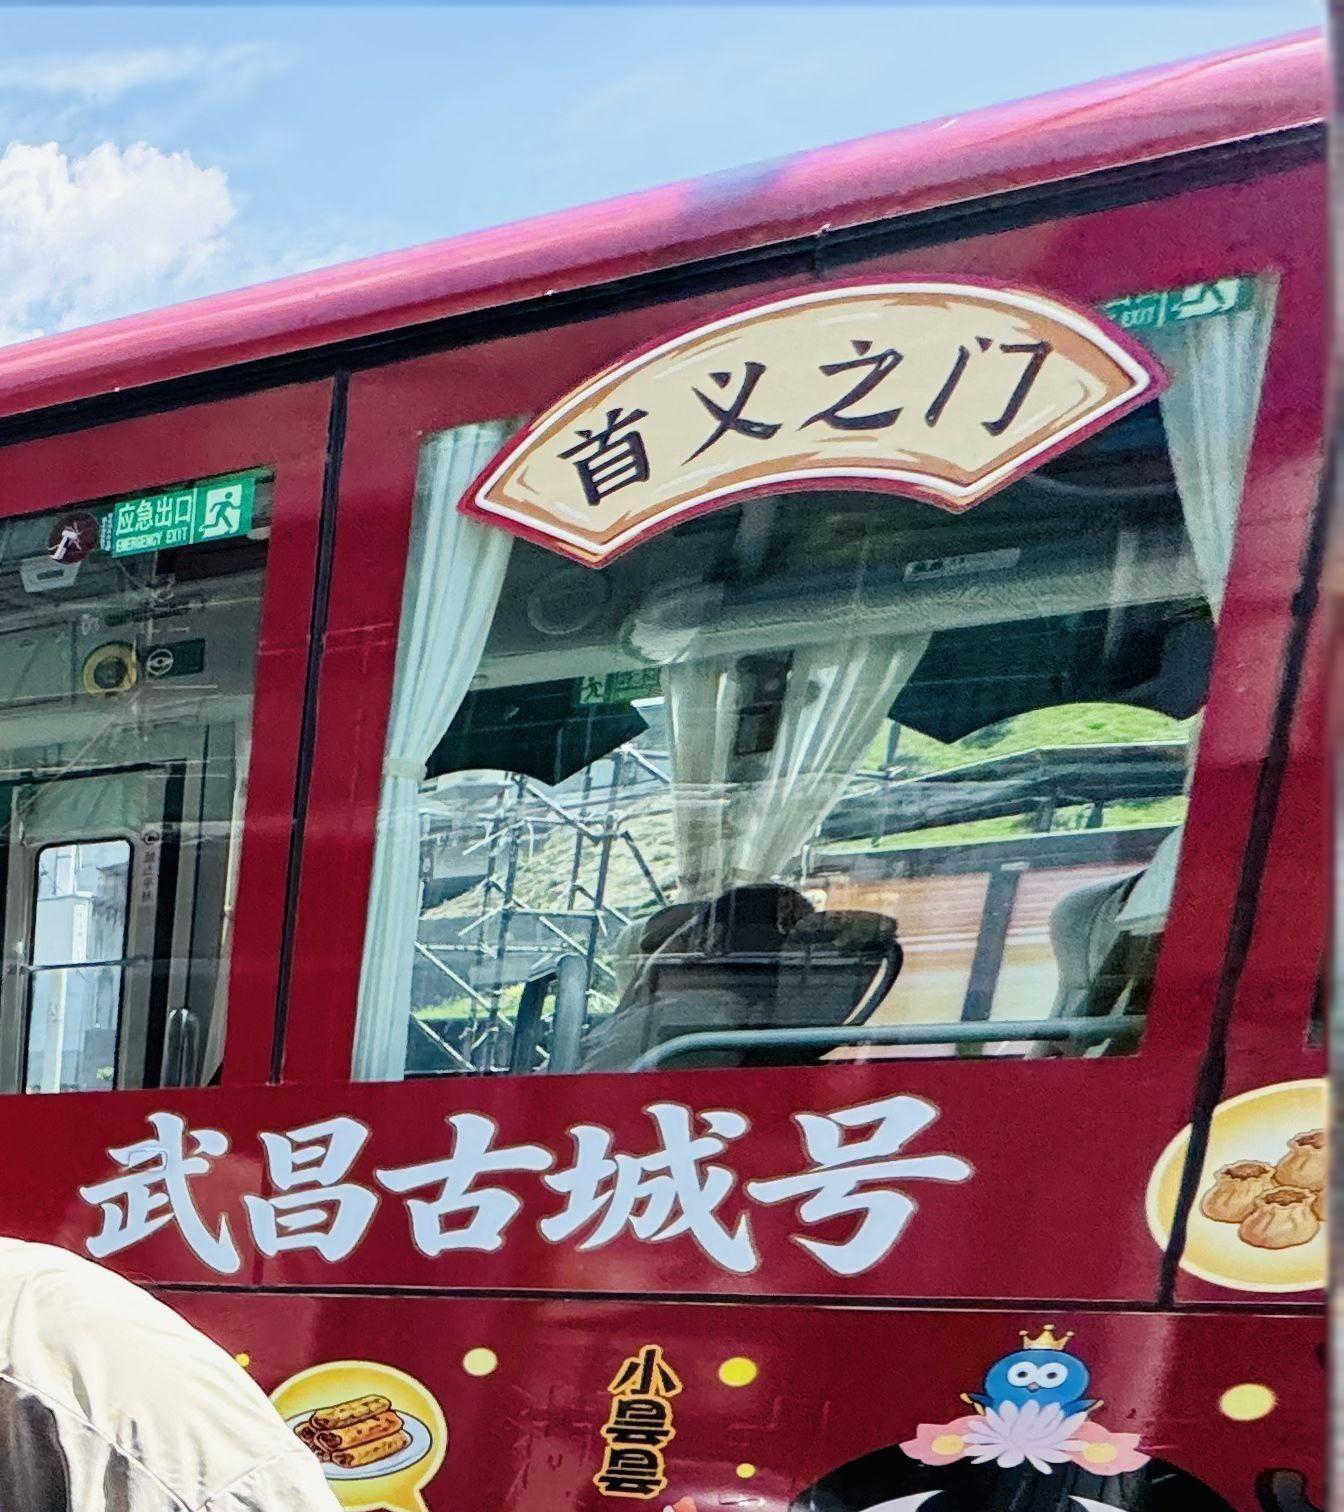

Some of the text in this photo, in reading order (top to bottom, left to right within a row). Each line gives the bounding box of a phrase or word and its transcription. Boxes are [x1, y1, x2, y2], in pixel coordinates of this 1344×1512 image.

[556, 336, 1054, 506] 首义之门
[115, 495, 193, 536] 应急出口
[166, 527, 188, 544] EXIT
[78, 1094, 974, 1276] 武昌古城号
[594, 1345, 682, 1498] 小昌昌
